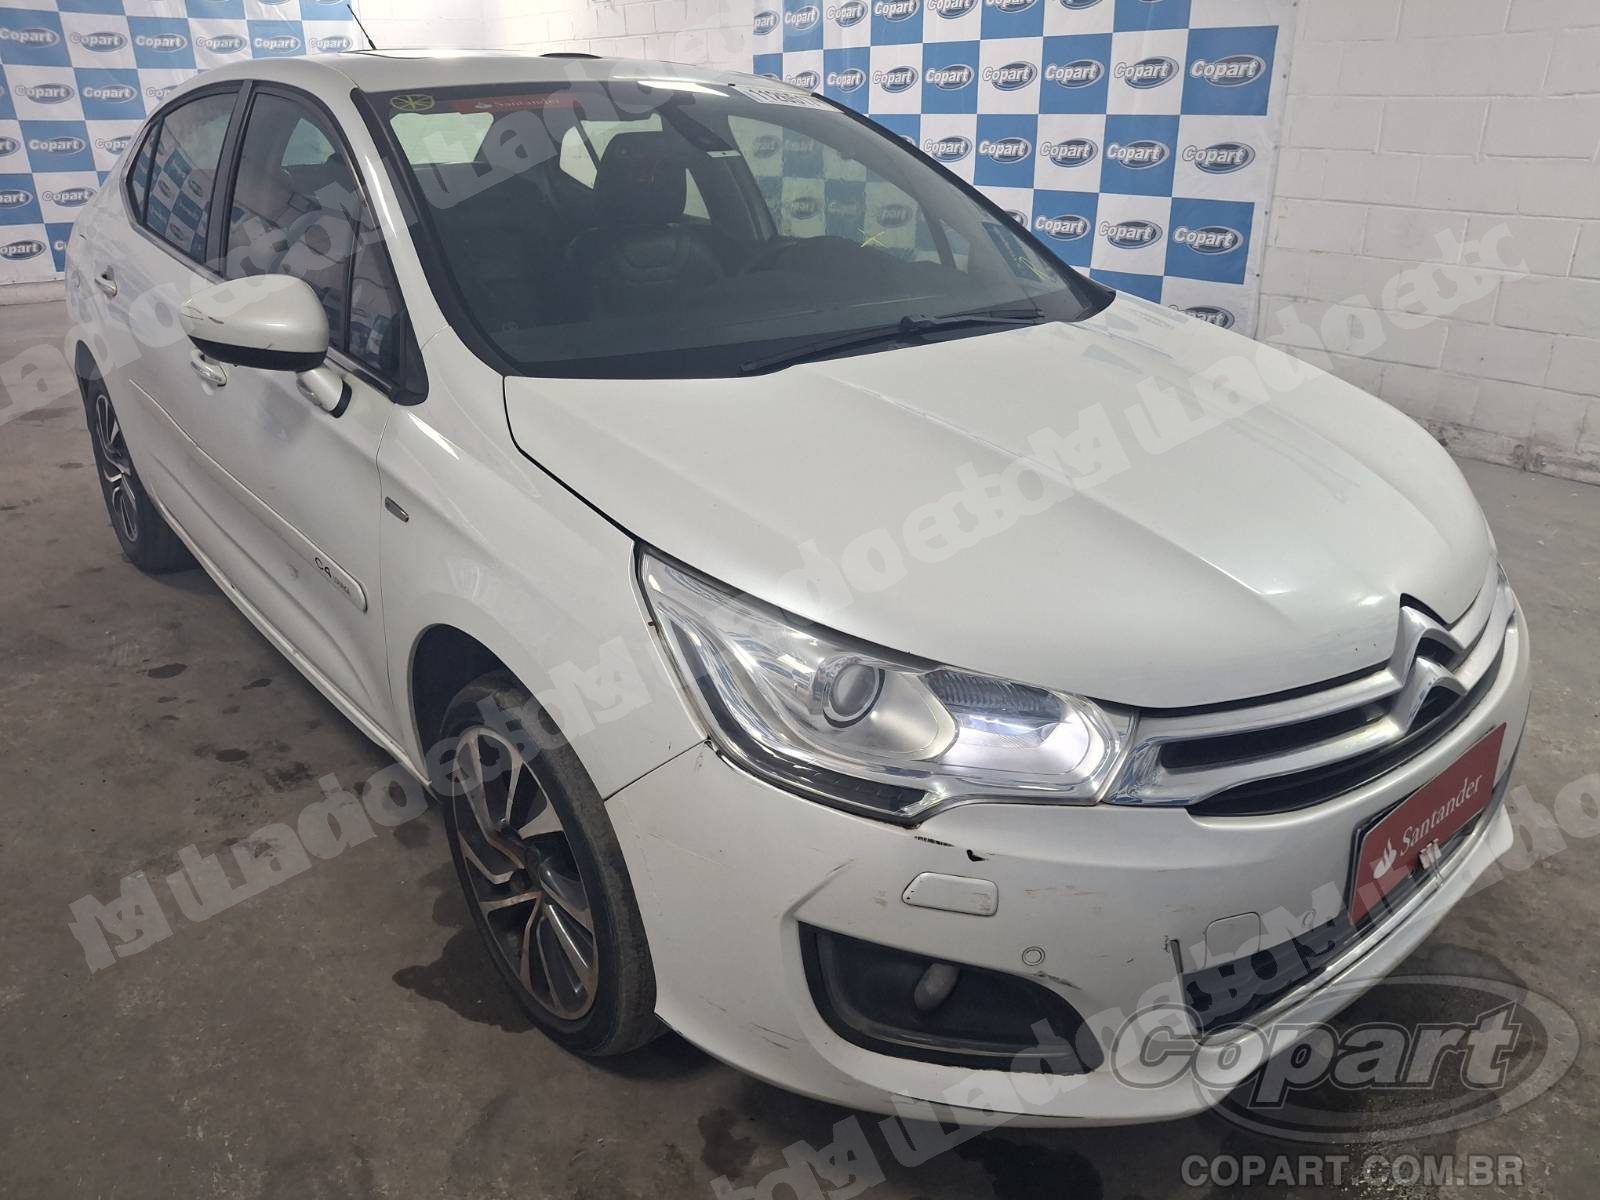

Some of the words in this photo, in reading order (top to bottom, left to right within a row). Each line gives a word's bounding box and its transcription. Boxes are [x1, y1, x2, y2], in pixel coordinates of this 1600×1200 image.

[826, 5, 861, 21] Copart
[873, 0, 914, 16] Copart
[753, 14, 775, 28] part
[784, 9, 816, 25] Copart
[0, 28, 54, 44] Copart
[70, 32, 120, 47] Copart
[135, 35, 182, 49] Copart
[196, 37, 241, 50] Copart
[254, 38, 296, 50] Copart
[309, 38, 348, 50] Copart
[926, 69, 969, 85] Copart
[982, 65, 1030, 83] Copart
[1045, 63, 1098, 83] Copart
[1114, 61, 1169, 81] Copart
[1191, 58, 1259, 81] Copart
[827, 71, 861, 87] Copart
[873, 71, 912, 88] Copart
[15, 86, 67, 99] Copart
[84, 86, 131, 100] Copart
[29, 139, 80, 152] Copart
[924, 139, 967, 158] Copart
[979, 140, 1026, 158] Copart
[1040, 141, 1090, 161] Copart
[1106, 143, 1161, 164] Copart
[1182, 145, 1244, 166] Copart
[42, 190, 90, 204] Copart
[1035, 215, 1085, 234] Copart
[1099, 220, 1152, 241] Copart
[1173, 226, 1235, 249] Copart
[0, 243, 38, 256] opart
[1400, 773, 1482, 857] Santander
